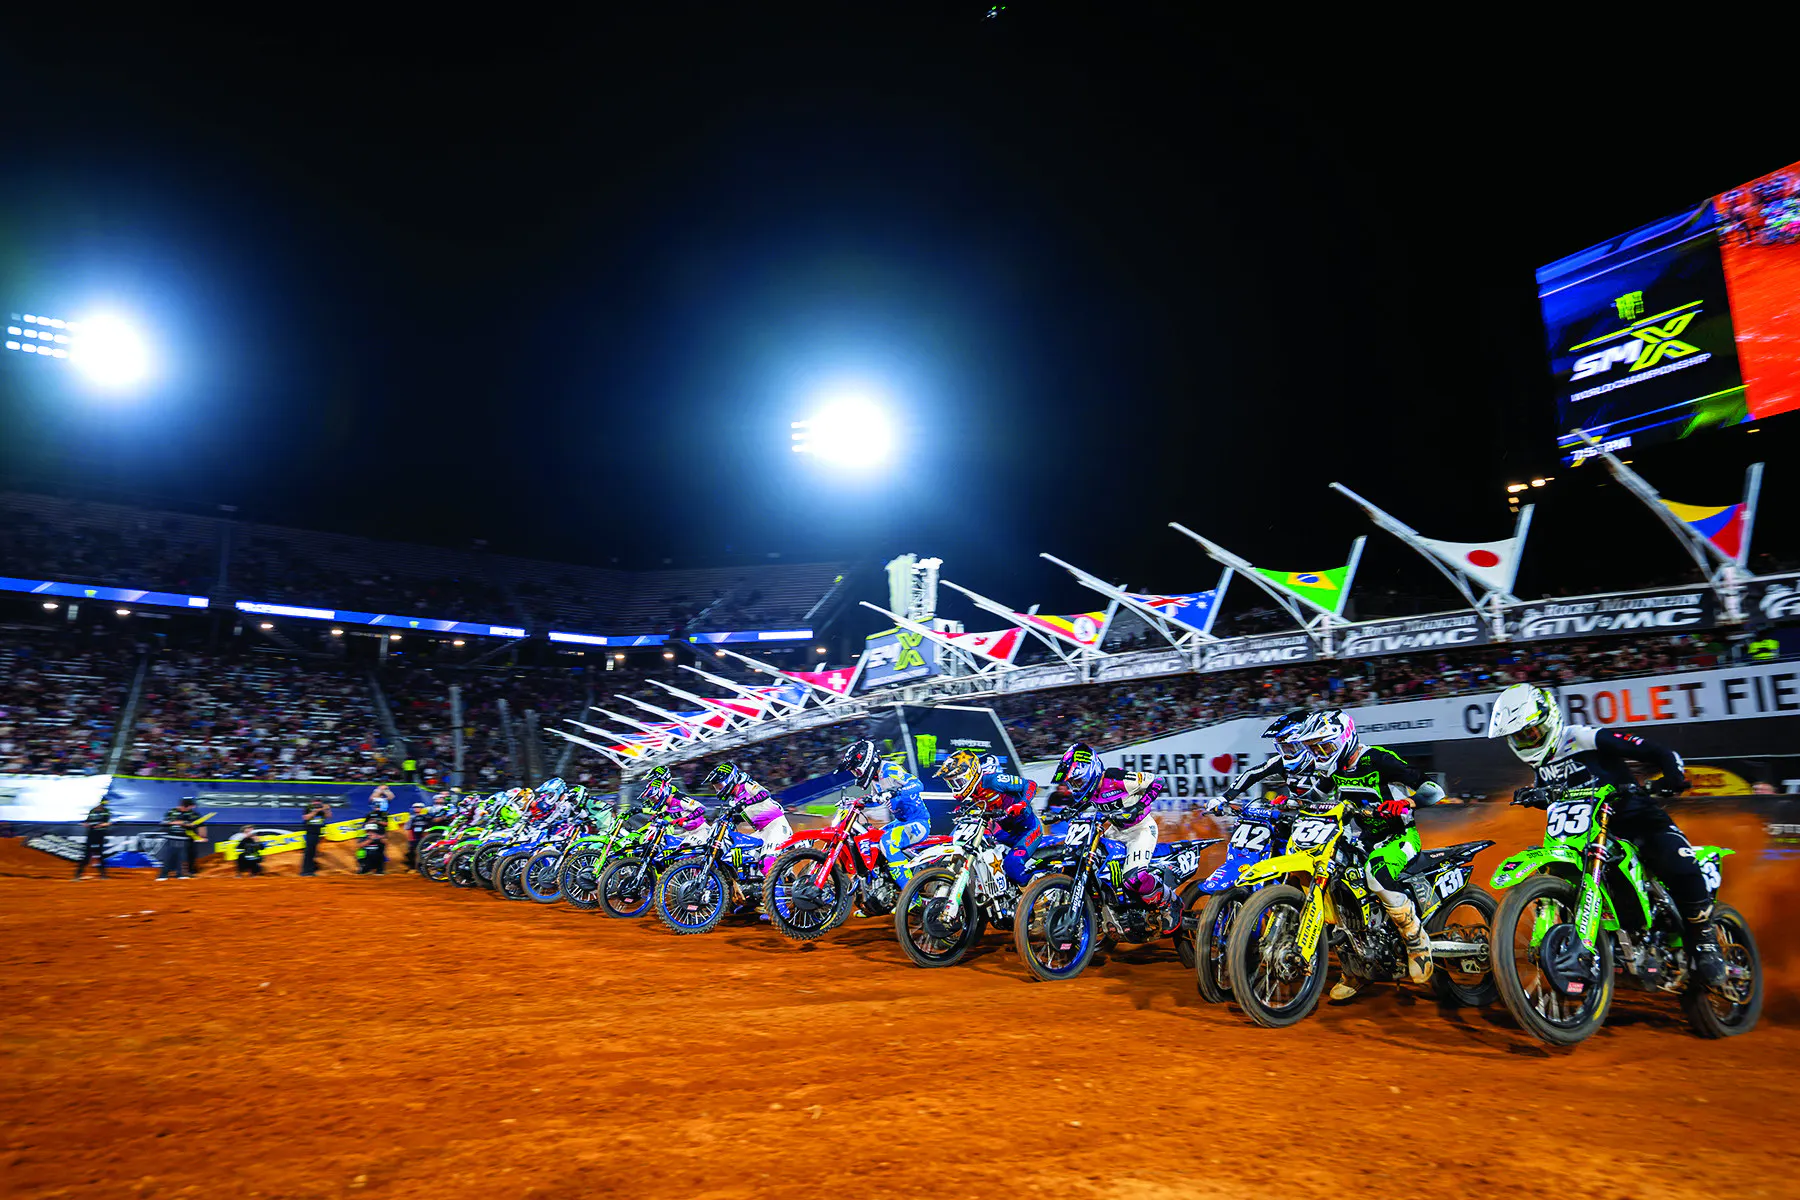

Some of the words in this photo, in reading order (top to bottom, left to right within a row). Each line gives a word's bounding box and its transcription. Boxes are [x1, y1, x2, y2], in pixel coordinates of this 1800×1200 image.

[1570, 312, 1702, 381] SMX
[1356, 718, 1435, 735] CHEVROLET
[1121, 753, 1205, 775] HEART
[1292, 820, 1337, 844] 131
[1546, 804, 1592, 837] 53
[1064, 823, 1091, 846] 82
[1230, 823, 1271, 851] 42
[1177, 850, 1199, 874] 82
[1435, 867, 1465, 899] 131
